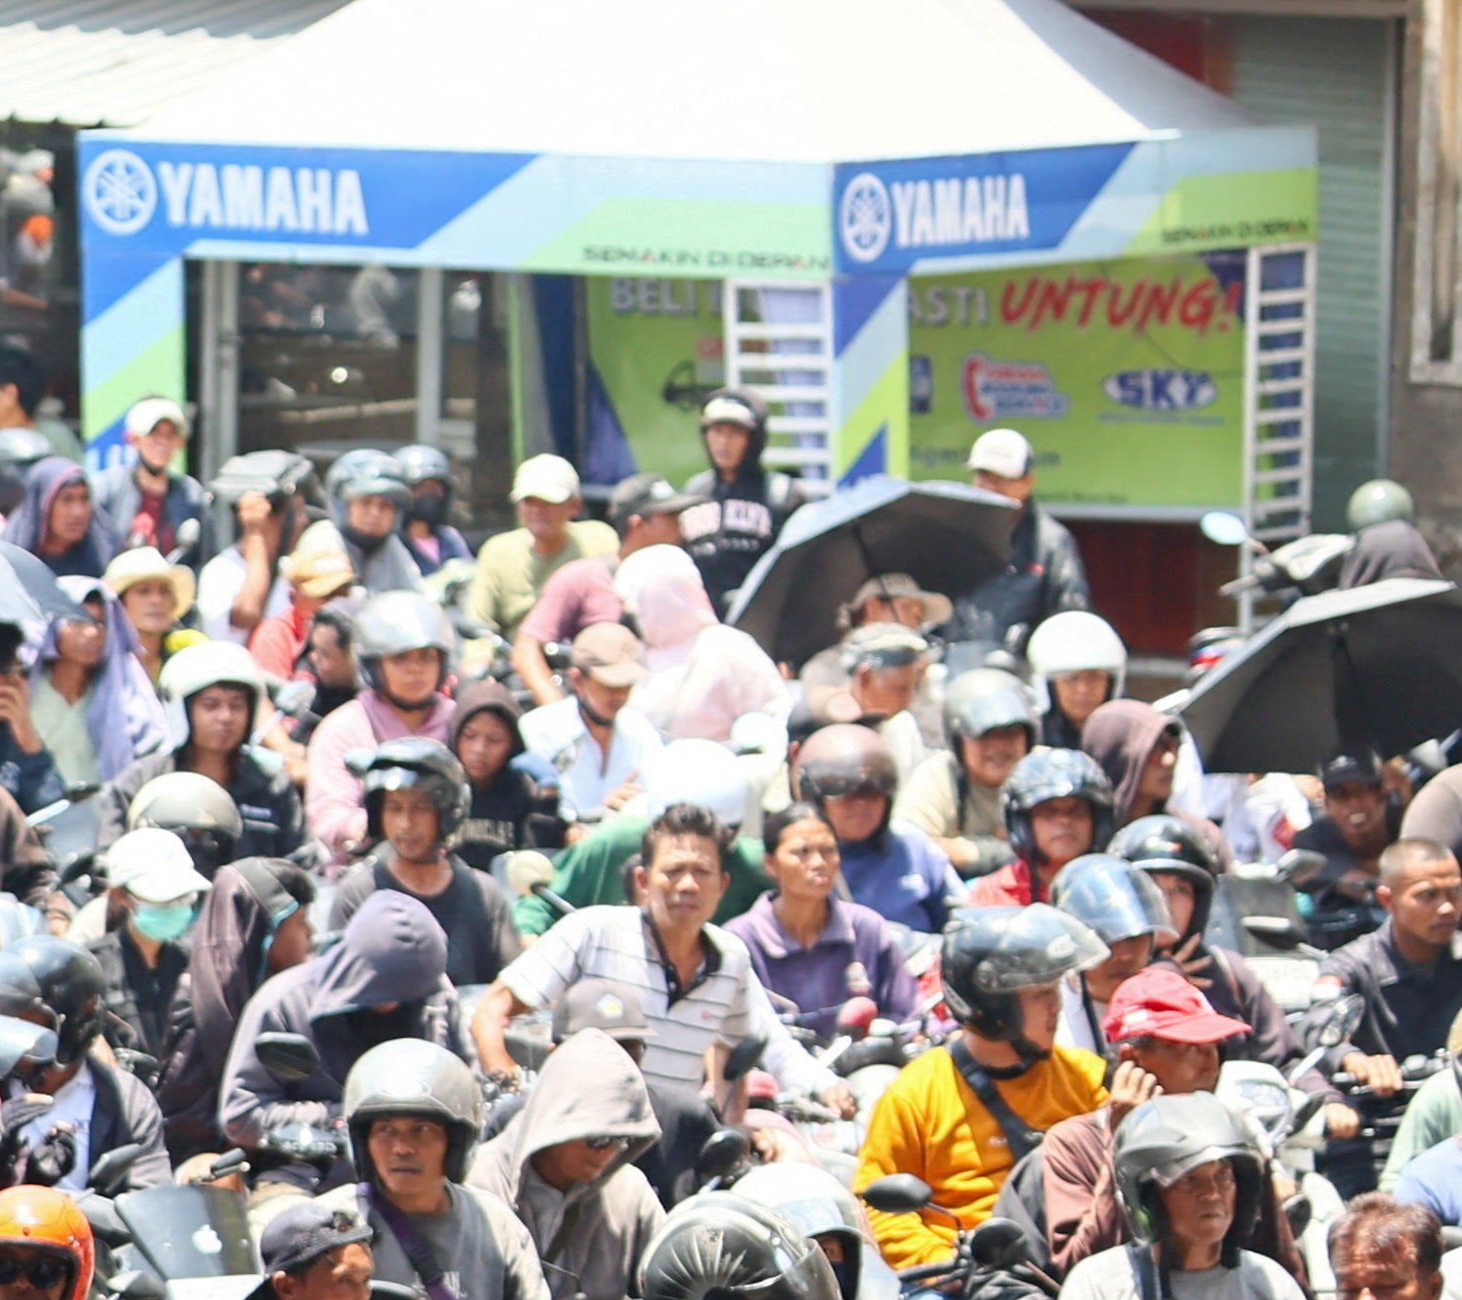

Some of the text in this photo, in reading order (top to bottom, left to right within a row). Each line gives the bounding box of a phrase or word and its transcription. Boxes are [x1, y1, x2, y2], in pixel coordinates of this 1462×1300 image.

[157, 161, 369, 236] YAMAHA
[891, 173, 1030, 248] YAMAHA
[583, 246, 829, 270] SEMAKIN DI DEPAN
[611, 276, 697, 314] BELI
[999, 274, 1242, 342] UNTUNG!
[1116, 369, 1211, 410] SKY
